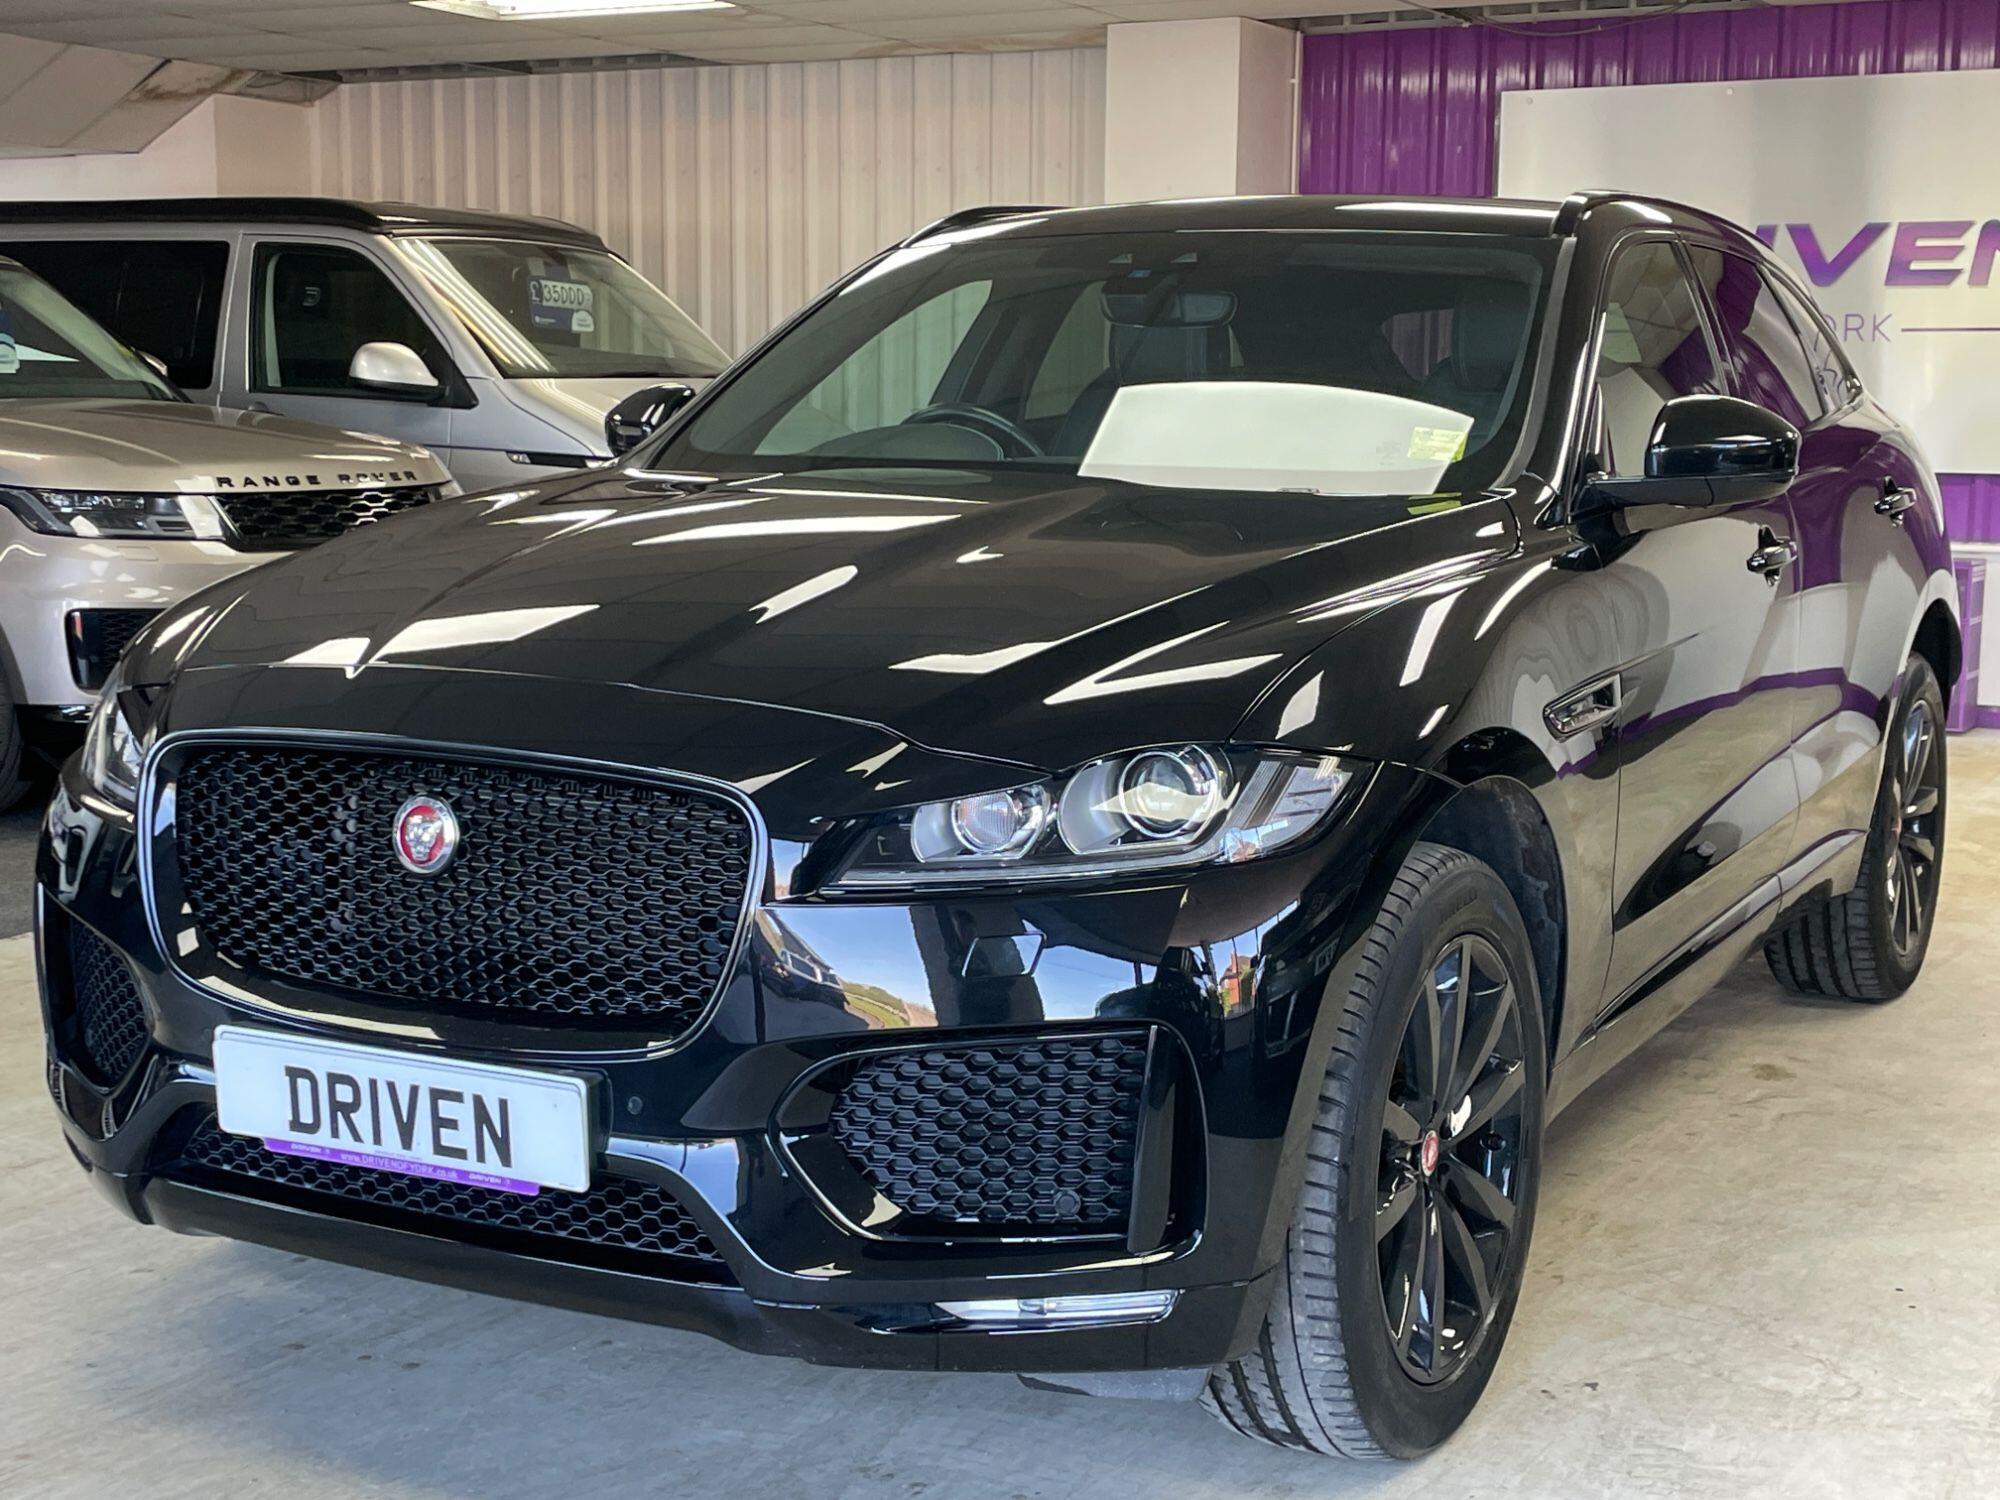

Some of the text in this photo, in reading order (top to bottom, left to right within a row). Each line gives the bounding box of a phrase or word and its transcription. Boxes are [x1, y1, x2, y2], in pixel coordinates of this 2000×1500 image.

[215, 470, 418, 488] RANGE ROVER
[284, 1065, 513, 1168] DRIVEN
